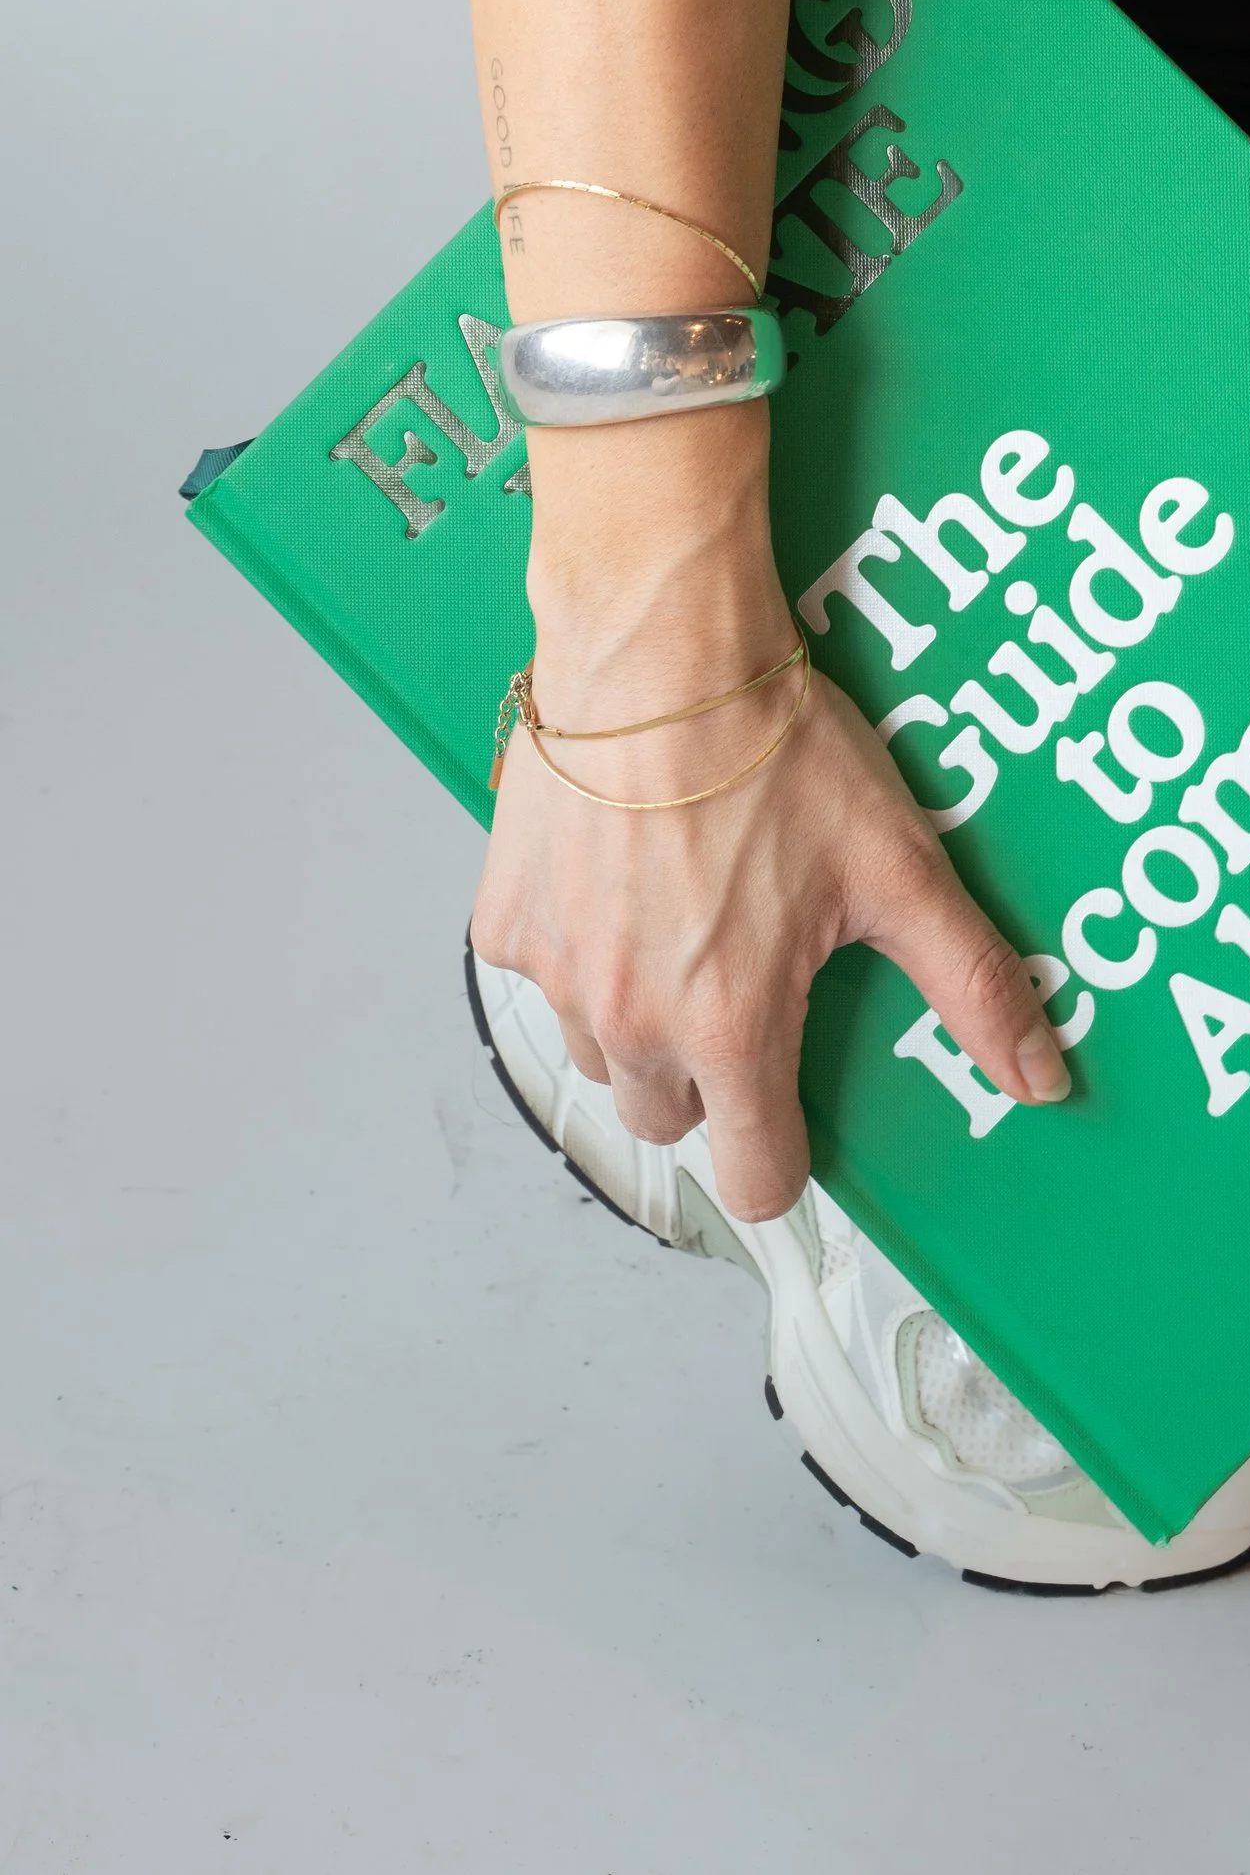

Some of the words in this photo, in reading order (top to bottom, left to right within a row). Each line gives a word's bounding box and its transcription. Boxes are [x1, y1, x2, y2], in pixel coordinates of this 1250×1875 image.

[490, 56, 513, 169] GOOD
[798, 429, 1075, 672] The
[874, 477, 1235, 834] Guide
[1055, 681, 1206, 824] to
